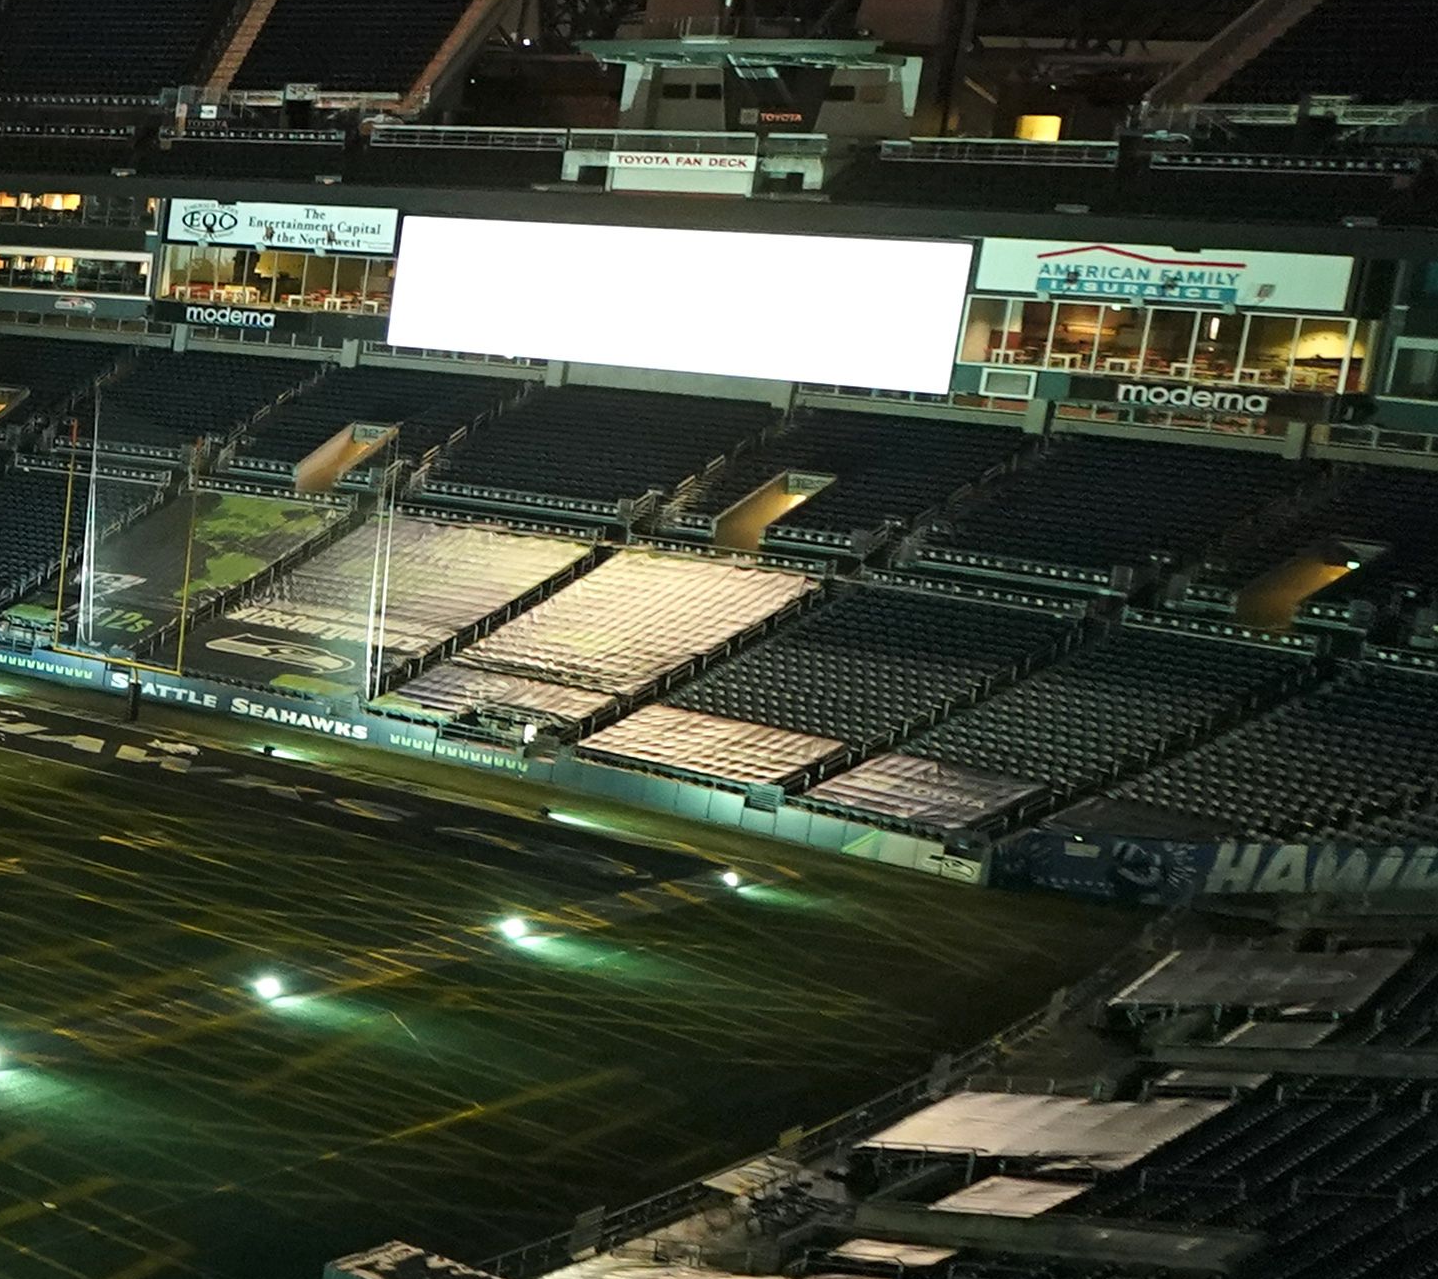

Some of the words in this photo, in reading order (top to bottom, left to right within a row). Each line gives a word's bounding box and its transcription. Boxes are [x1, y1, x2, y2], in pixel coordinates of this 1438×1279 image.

[761, 111, 803, 122] TOYOTA
[617, 154, 670, 165] TOYOTA
[675, 156, 702, 166] FAN
[709, 156, 748, 168] DECK
[189, 210, 236, 233] EQC
[304, 207, 326, 221] The
[248, 216, 334, 233] Entertainment
[337, 220, 382, 235] Capital
[277, 232, 296, 244] the
[1039, 263, 1152, 282] AMERICAN
[1161, 267, 1241, 287] FAMILY
[1048, 279, 1223, 300] INSURANCE
[186, 305, 277, 328] moderna
[1117, 382, 1269, 414] moderna
[230, 697, 369, 740] SEAHAWKS
